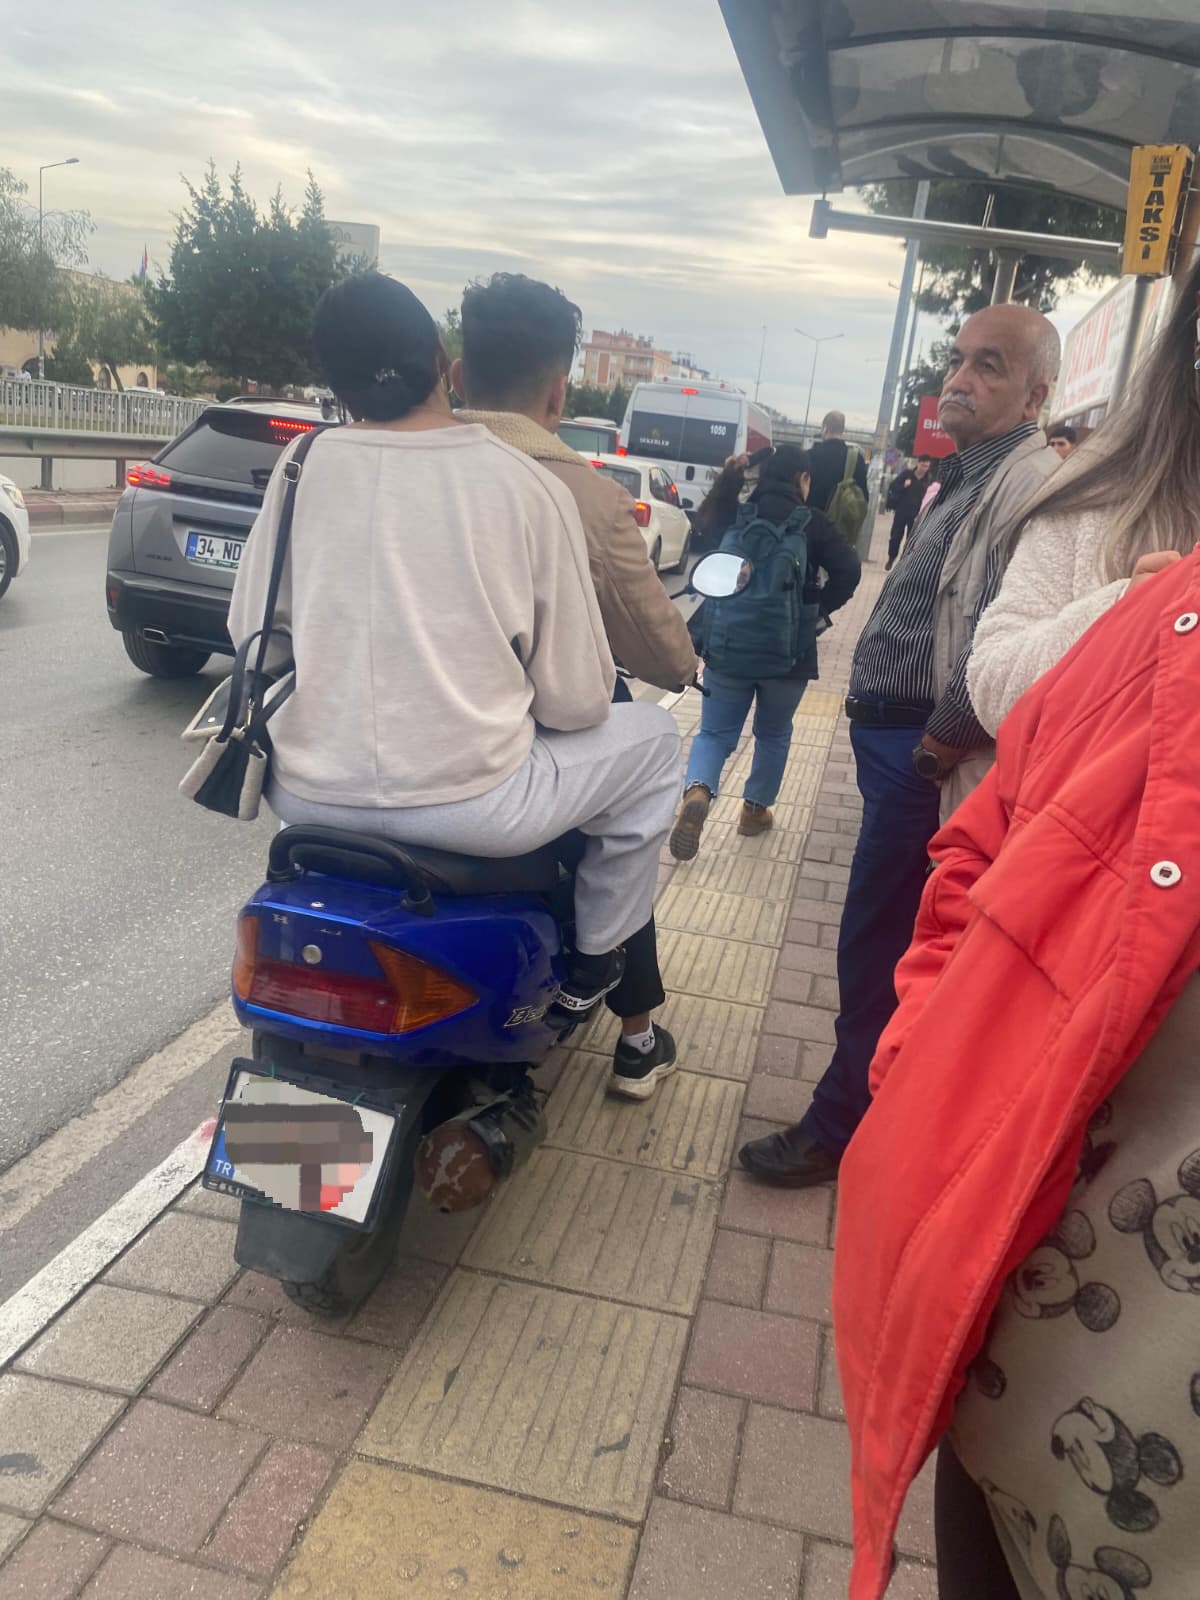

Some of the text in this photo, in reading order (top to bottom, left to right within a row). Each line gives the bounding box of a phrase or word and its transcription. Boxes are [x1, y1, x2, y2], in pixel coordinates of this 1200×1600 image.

[198, 538, 244, 561] 34 ND
[215, 1159, 232, 1176] TR
